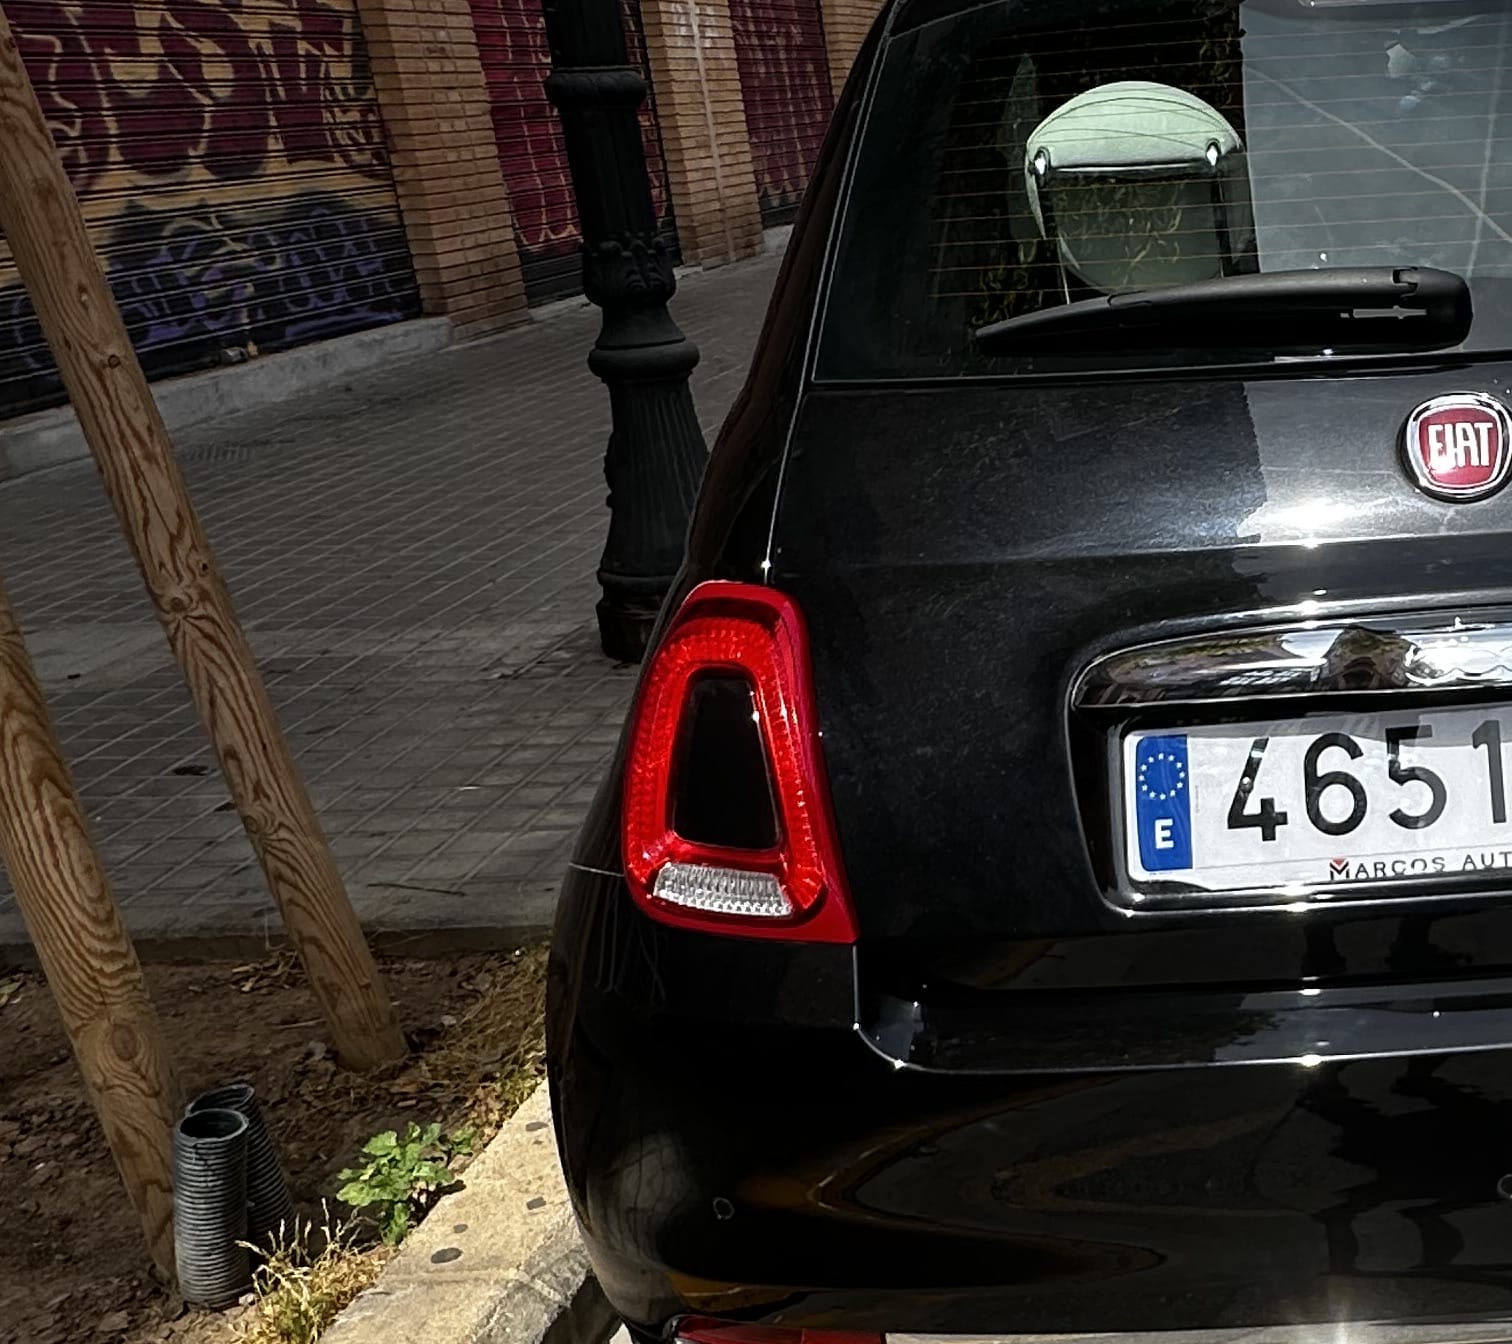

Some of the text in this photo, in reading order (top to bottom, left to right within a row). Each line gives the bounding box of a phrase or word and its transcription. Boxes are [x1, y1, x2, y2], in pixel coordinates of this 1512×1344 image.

[1428, 422, 1494, 471] FIAT
[1155, 818, 1174, 849] E
[1227, 720, 1507, 841] 4651
[1329, 856, 1446, 881] MARCOS
